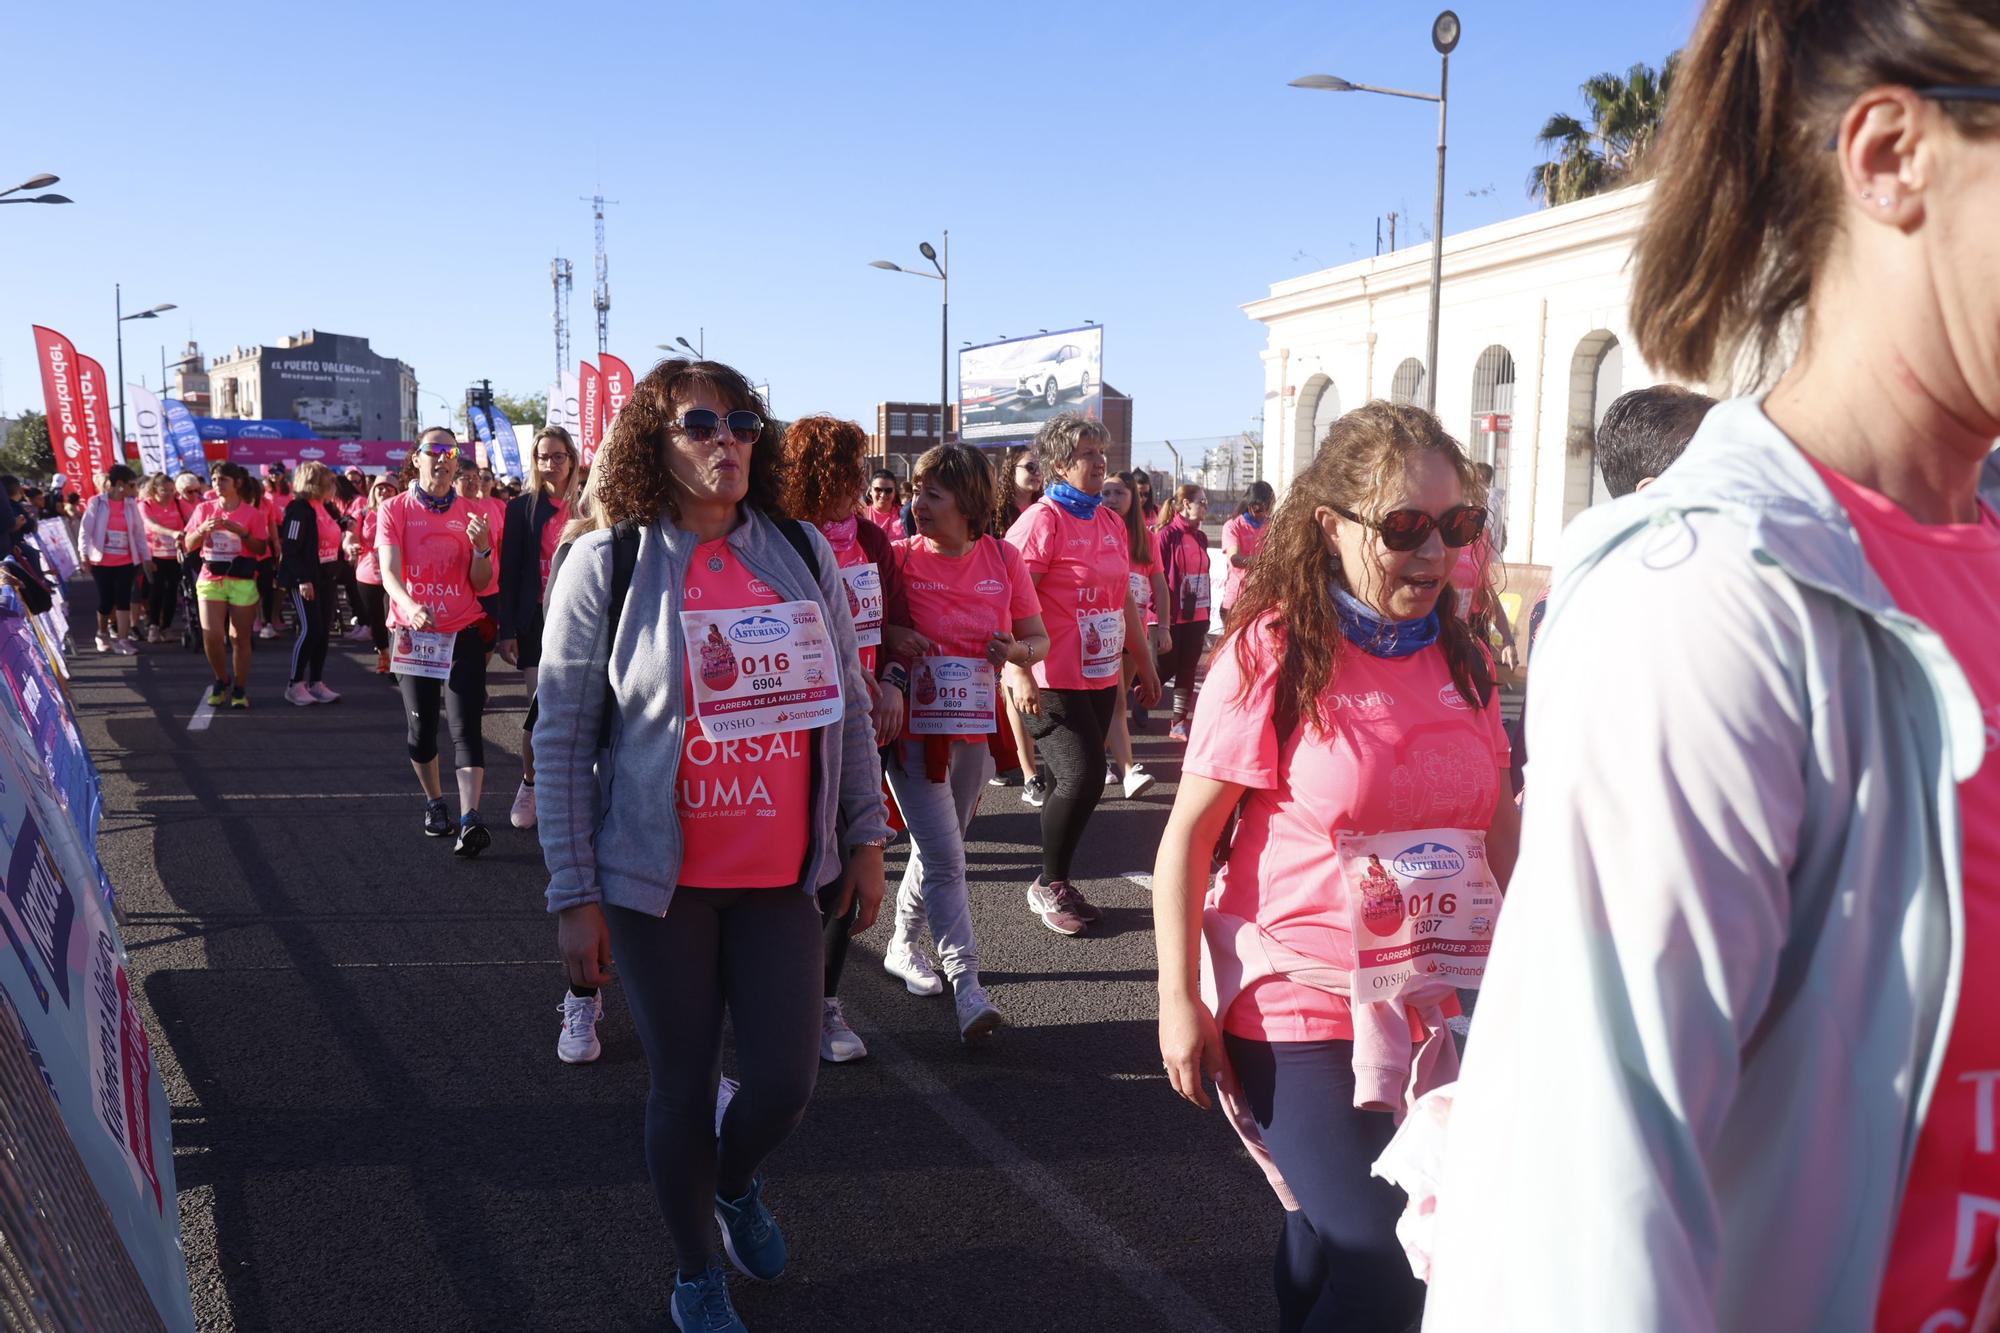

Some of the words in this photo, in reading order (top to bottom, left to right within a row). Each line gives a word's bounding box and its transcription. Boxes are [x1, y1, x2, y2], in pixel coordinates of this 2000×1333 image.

[271, 361, 282, 370] EL
[283, 360, 320, 372] PUERTO
[1076, 588, 1097, 603] TU
[793, 616, 817, 625] SUMA
[735, 626, 787, 639] ASTURIANA
[741, 652, 790, 675] 016
[752, 676, 783, 690] 6904
[714, 700, 752, 711] CARRERA
[754, 697, 766, 706] DE
[767, 696, 777, 704] LA
[779, 692, 807, 702] MUJER
[809, 690, 827, 698] 2023
[939, 687, 967, 698] 016
[1326, 690, 1394, 711] OYSHO
[713, 717, 755, 732] OYSHO
[789, 707, 833, 720] Santander
[917, 721, 943, 729] OYSHO
[686, 731, 801, 766] ORSAL
[678, 775, 773, 809] UMA
[720, 809, 747, 817] MUJER
[756, 809, 777, 817] 2023
[1401, 858, 1461, 872] ASTURIANA
[1408, 892, 1457, 917] 016
[1414, 919, 1442, 935] 1307
[1376, 947, 1411, 962] CARRERA
[1411, 944, 1421, 954] DE
[1421, 943, 1430, 952] LA
[1431, 942, 1467, 953] MUJER
[1469, 944, 1490, 953] 2023
[1372, 969, 1411, 989] OYSHO
[1439, 962, 1485, 977] Santand
[1958, 1069, 2000, 1154] T
